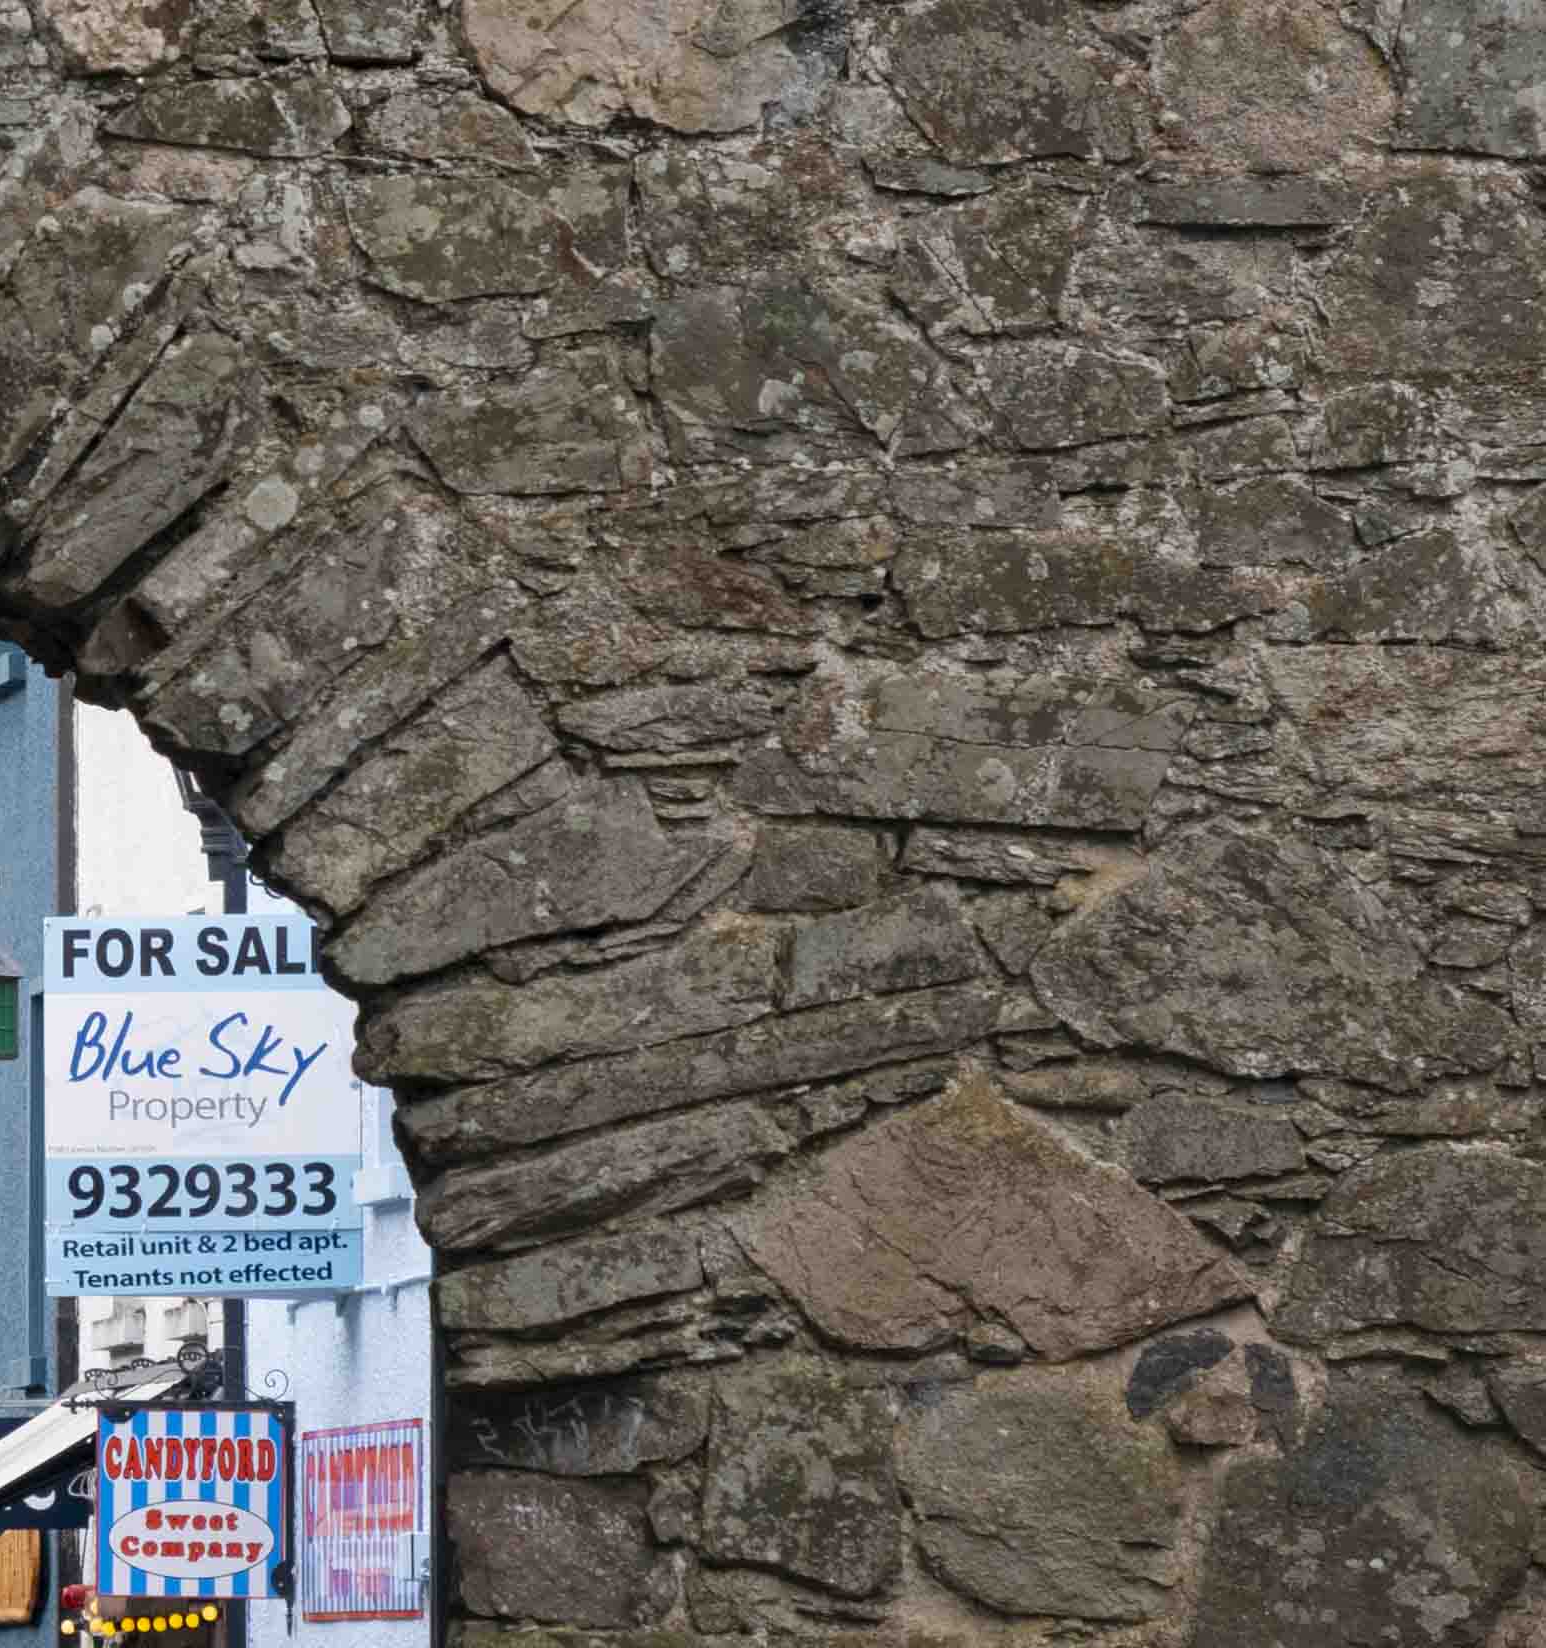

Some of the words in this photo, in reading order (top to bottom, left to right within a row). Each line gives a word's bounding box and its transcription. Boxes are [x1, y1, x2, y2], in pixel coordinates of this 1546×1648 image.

[62, 928, 177, 978] FOR
[196, 925, 320, 977] SAL
[69, 1010, 181, 1083] Blue
[199, 1011, 330, 1107] Sky
[108, 1090, 267, 1128] Property
[67, 1161, 337, 1219] 9329333
[62, 1237, 135, 1258] Retail
[141, 1235, 192, 1256] unit
[197, 1235, 217, 1254] &
[222, 1234, 238, 1253] 2
[244, 1231, 292, 1252] bed
[298, 1233, 349, 1255] apt.
[74, 1269, 174, 1288] Tenants
[180, 1267, 222, 1285] not
[228, 1261, 333, 1282] effected
[105, 1436, 276, 1481] CANDYFORD
[145, 1509, 238, 1531] Sweet
[120, 1536, 264, 1563] Company
